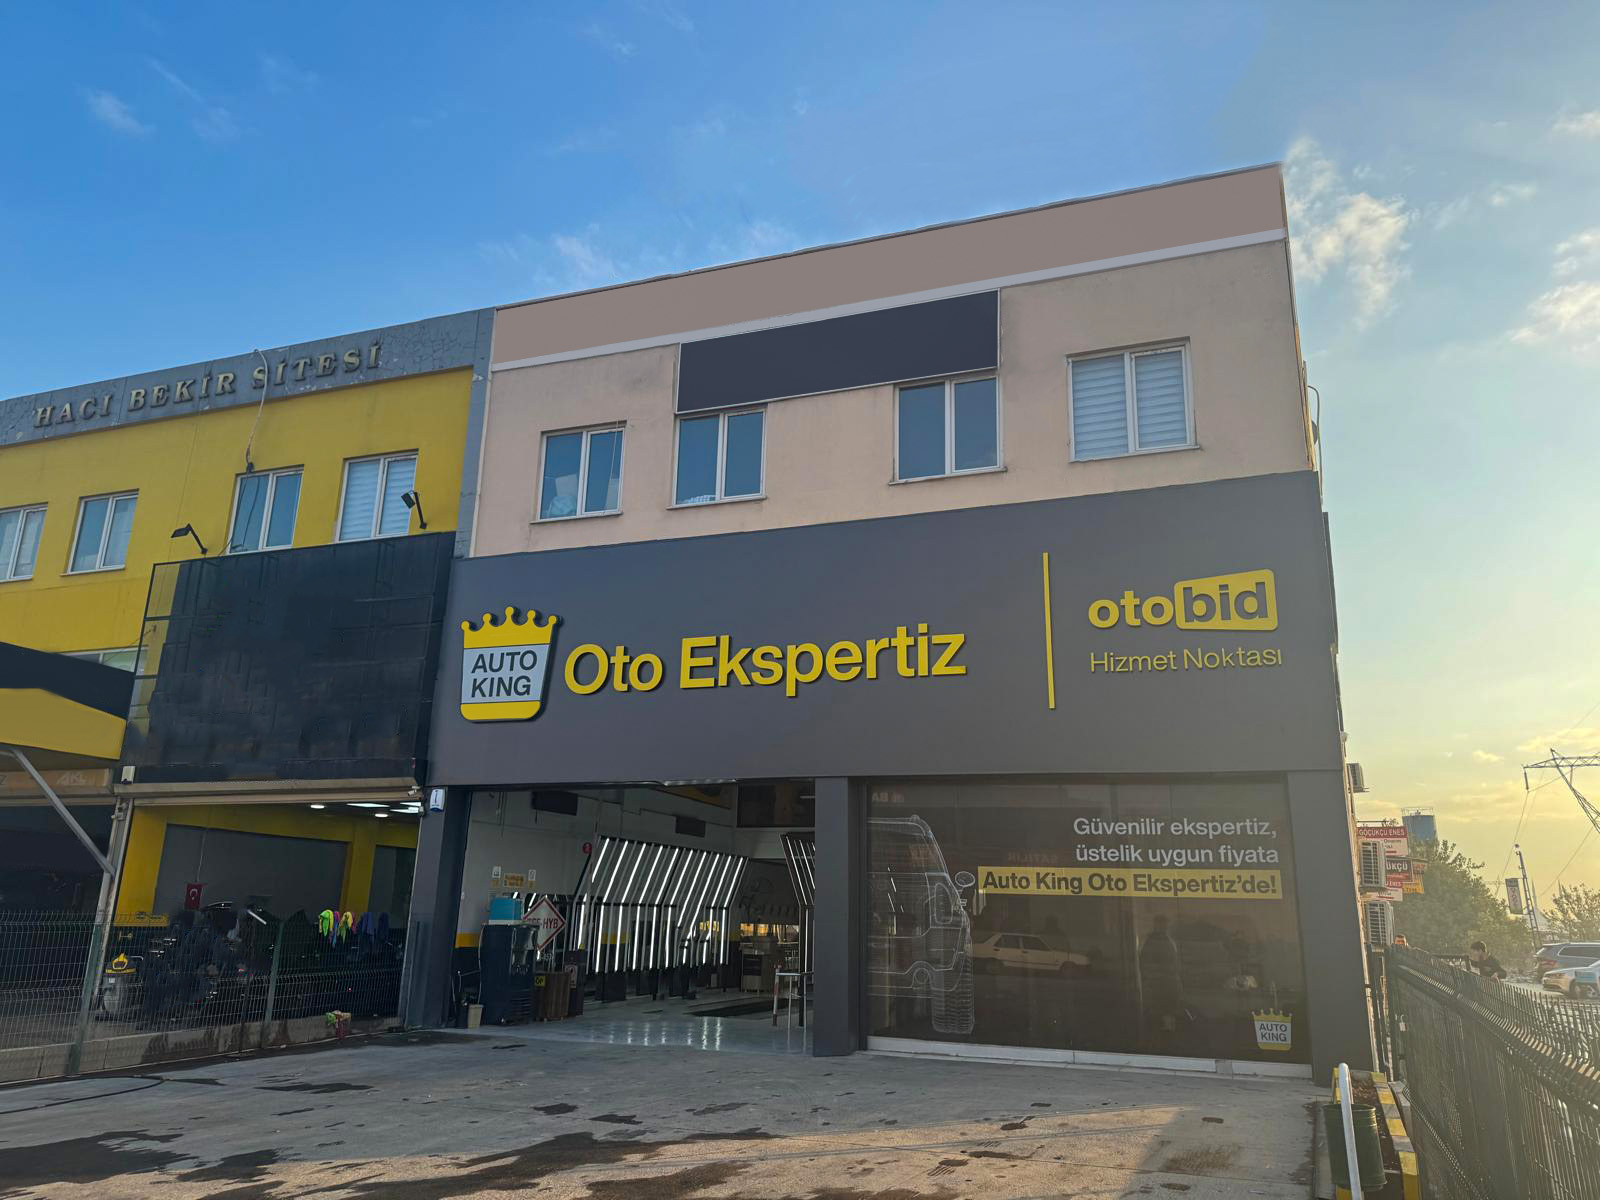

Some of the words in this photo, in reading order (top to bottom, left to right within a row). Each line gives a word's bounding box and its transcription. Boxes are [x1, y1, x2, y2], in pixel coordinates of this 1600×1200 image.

[33, 395, 113, 428] HACI
[129, 372, 235, 411] BEKİR
[252, 341, 382, 389] SİTESİ
[1088, 579, 1271, 629] otobid
[471, 649, 537, 674] AUTO
[564, 643, 663, 695] Oto
[680, 623, 967, 697] Ekspertiz
[1090, 650, 1178, 673] Hizmet
[1183, 646, 1282, 670] Noktası
[470, 674, 531, 698] KING
[1073, 816, 1164, 837] Güvenilir
[1170, 816, 1277, 840] ekspertiz,
[1075, 844, 1143, 863] üstelik
[1148, 848, 1214, 867] uygun
[1218, 846, 1279, 867] fiyata
[982, 871, 1030, 890] Auto
[1035, 872, 1083, 894] King
[1087, 872, 1127, 891] Oto
[1259, 1023, 1287, 1032] AUTO
[1260, 1032, 1287, 1041] KING
